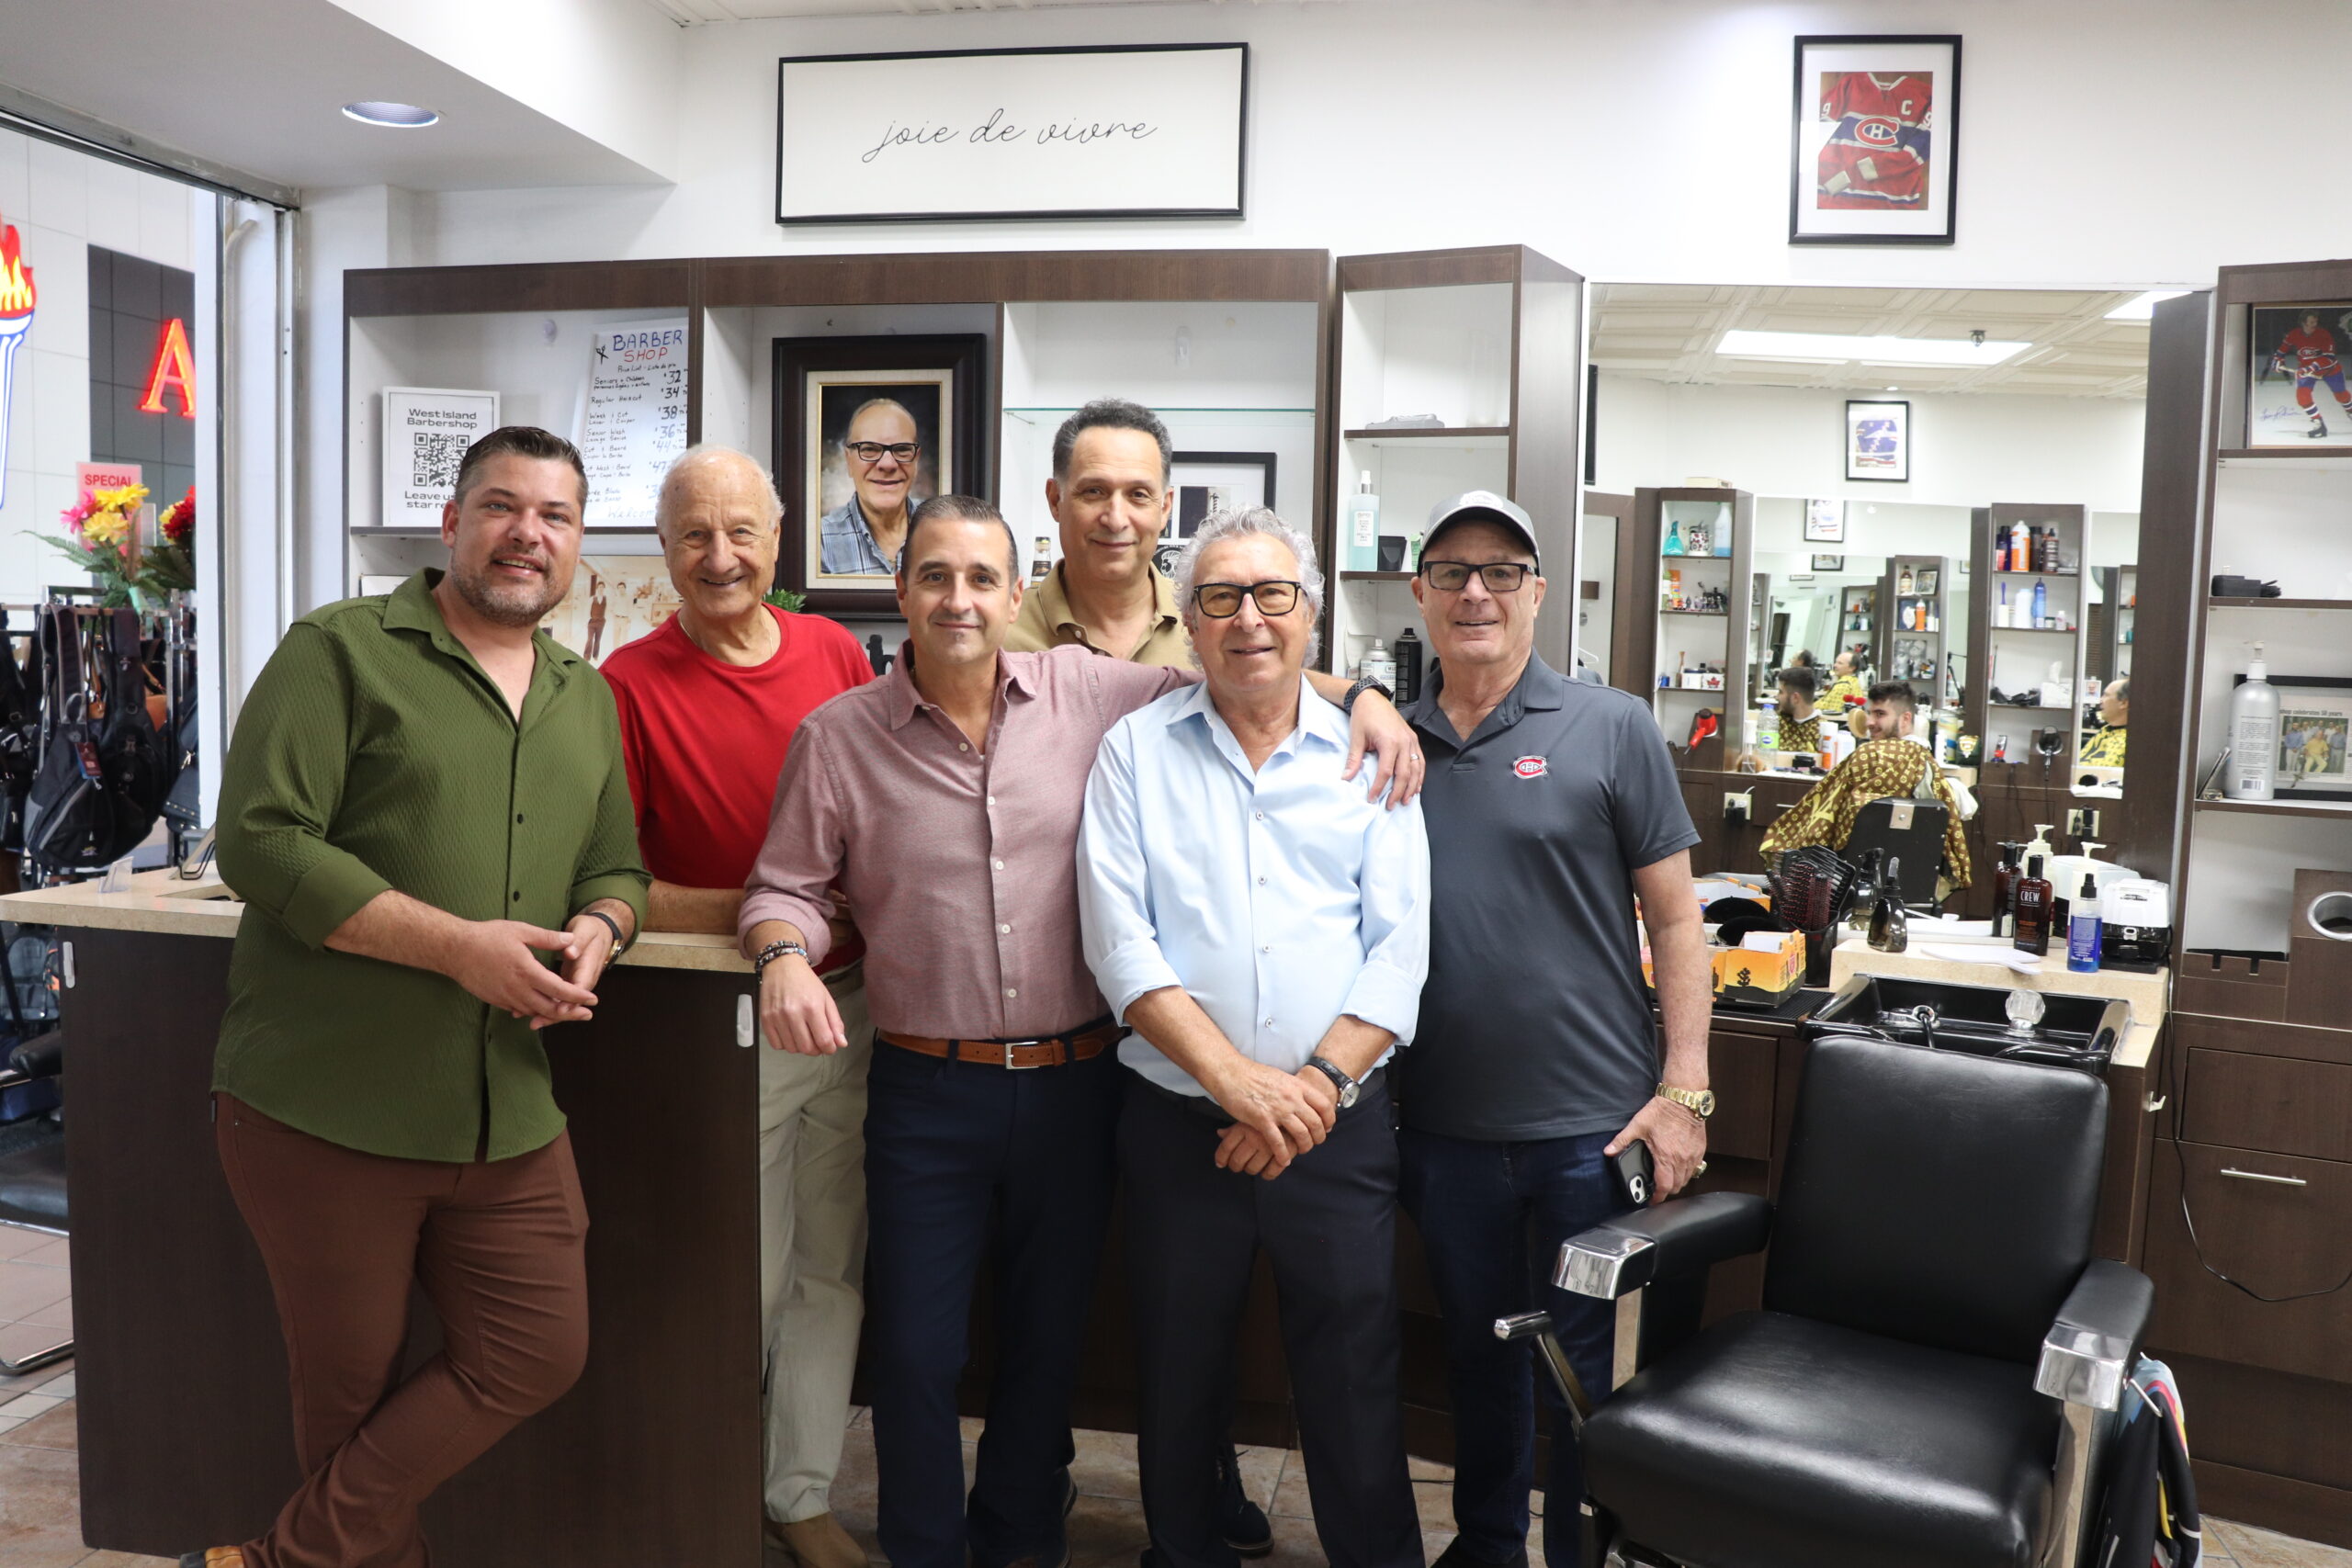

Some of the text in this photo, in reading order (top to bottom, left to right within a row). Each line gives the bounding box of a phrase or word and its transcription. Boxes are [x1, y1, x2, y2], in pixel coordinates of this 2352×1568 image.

[1901, 99, 1913, 116] C
[862, 107, 1159, 164] joie de vivre
[613, 329, 683, 351] BARBER
[624, 346, 668, 363] SHOP
[139, 318, 196, 417] A
[591, 397, 614, 407] Regular
[409, 409, 477, 420] West Island
[407, 417, 478, 430] Barbershop
[404, 491, 441, 500] Leave
[607, 505, 656, 518] Welcom
[2020, 890, 2041, 902] CREW
